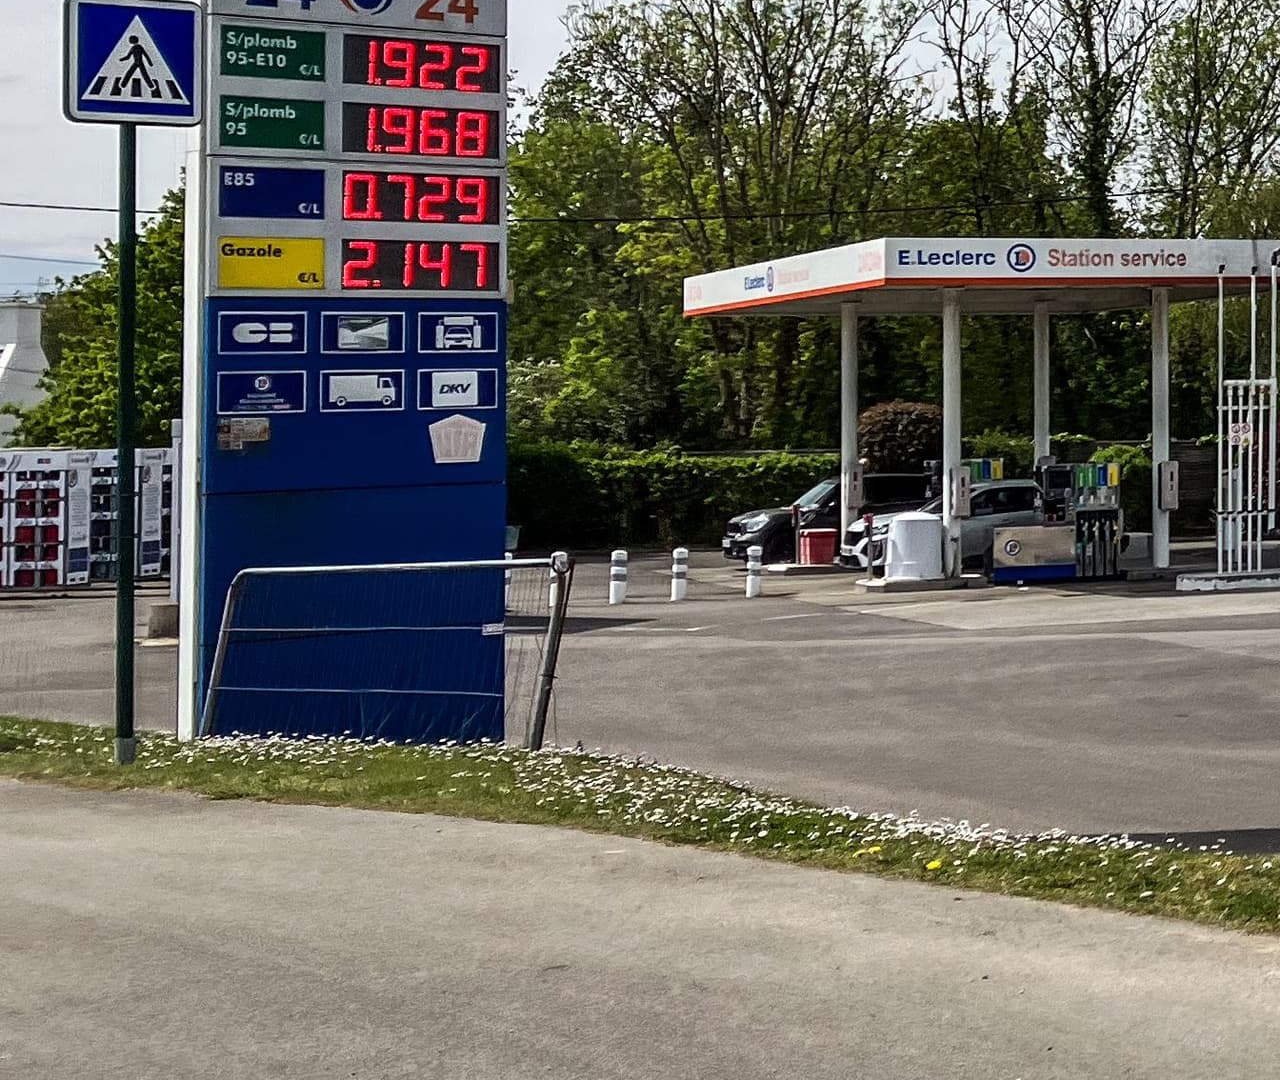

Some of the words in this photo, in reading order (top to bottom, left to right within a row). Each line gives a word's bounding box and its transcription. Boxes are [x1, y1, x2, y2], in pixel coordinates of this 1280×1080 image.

[226, 31, 297, 50] S/plomb
[226, 51, 287, 68] 95-E10
[225, 102, 297, 122] S/plomb
[226, 122, 248, 137] 95
[224, 171, 255, 187] E85
[221, 243, 283, 258] Gazole
[897, 249, 997, 266] E.Leclerc
[1048, 248, 1114, 267] Station
[1120, 249, 1187, 267] service
[438, 383, 472, 395] DKV
